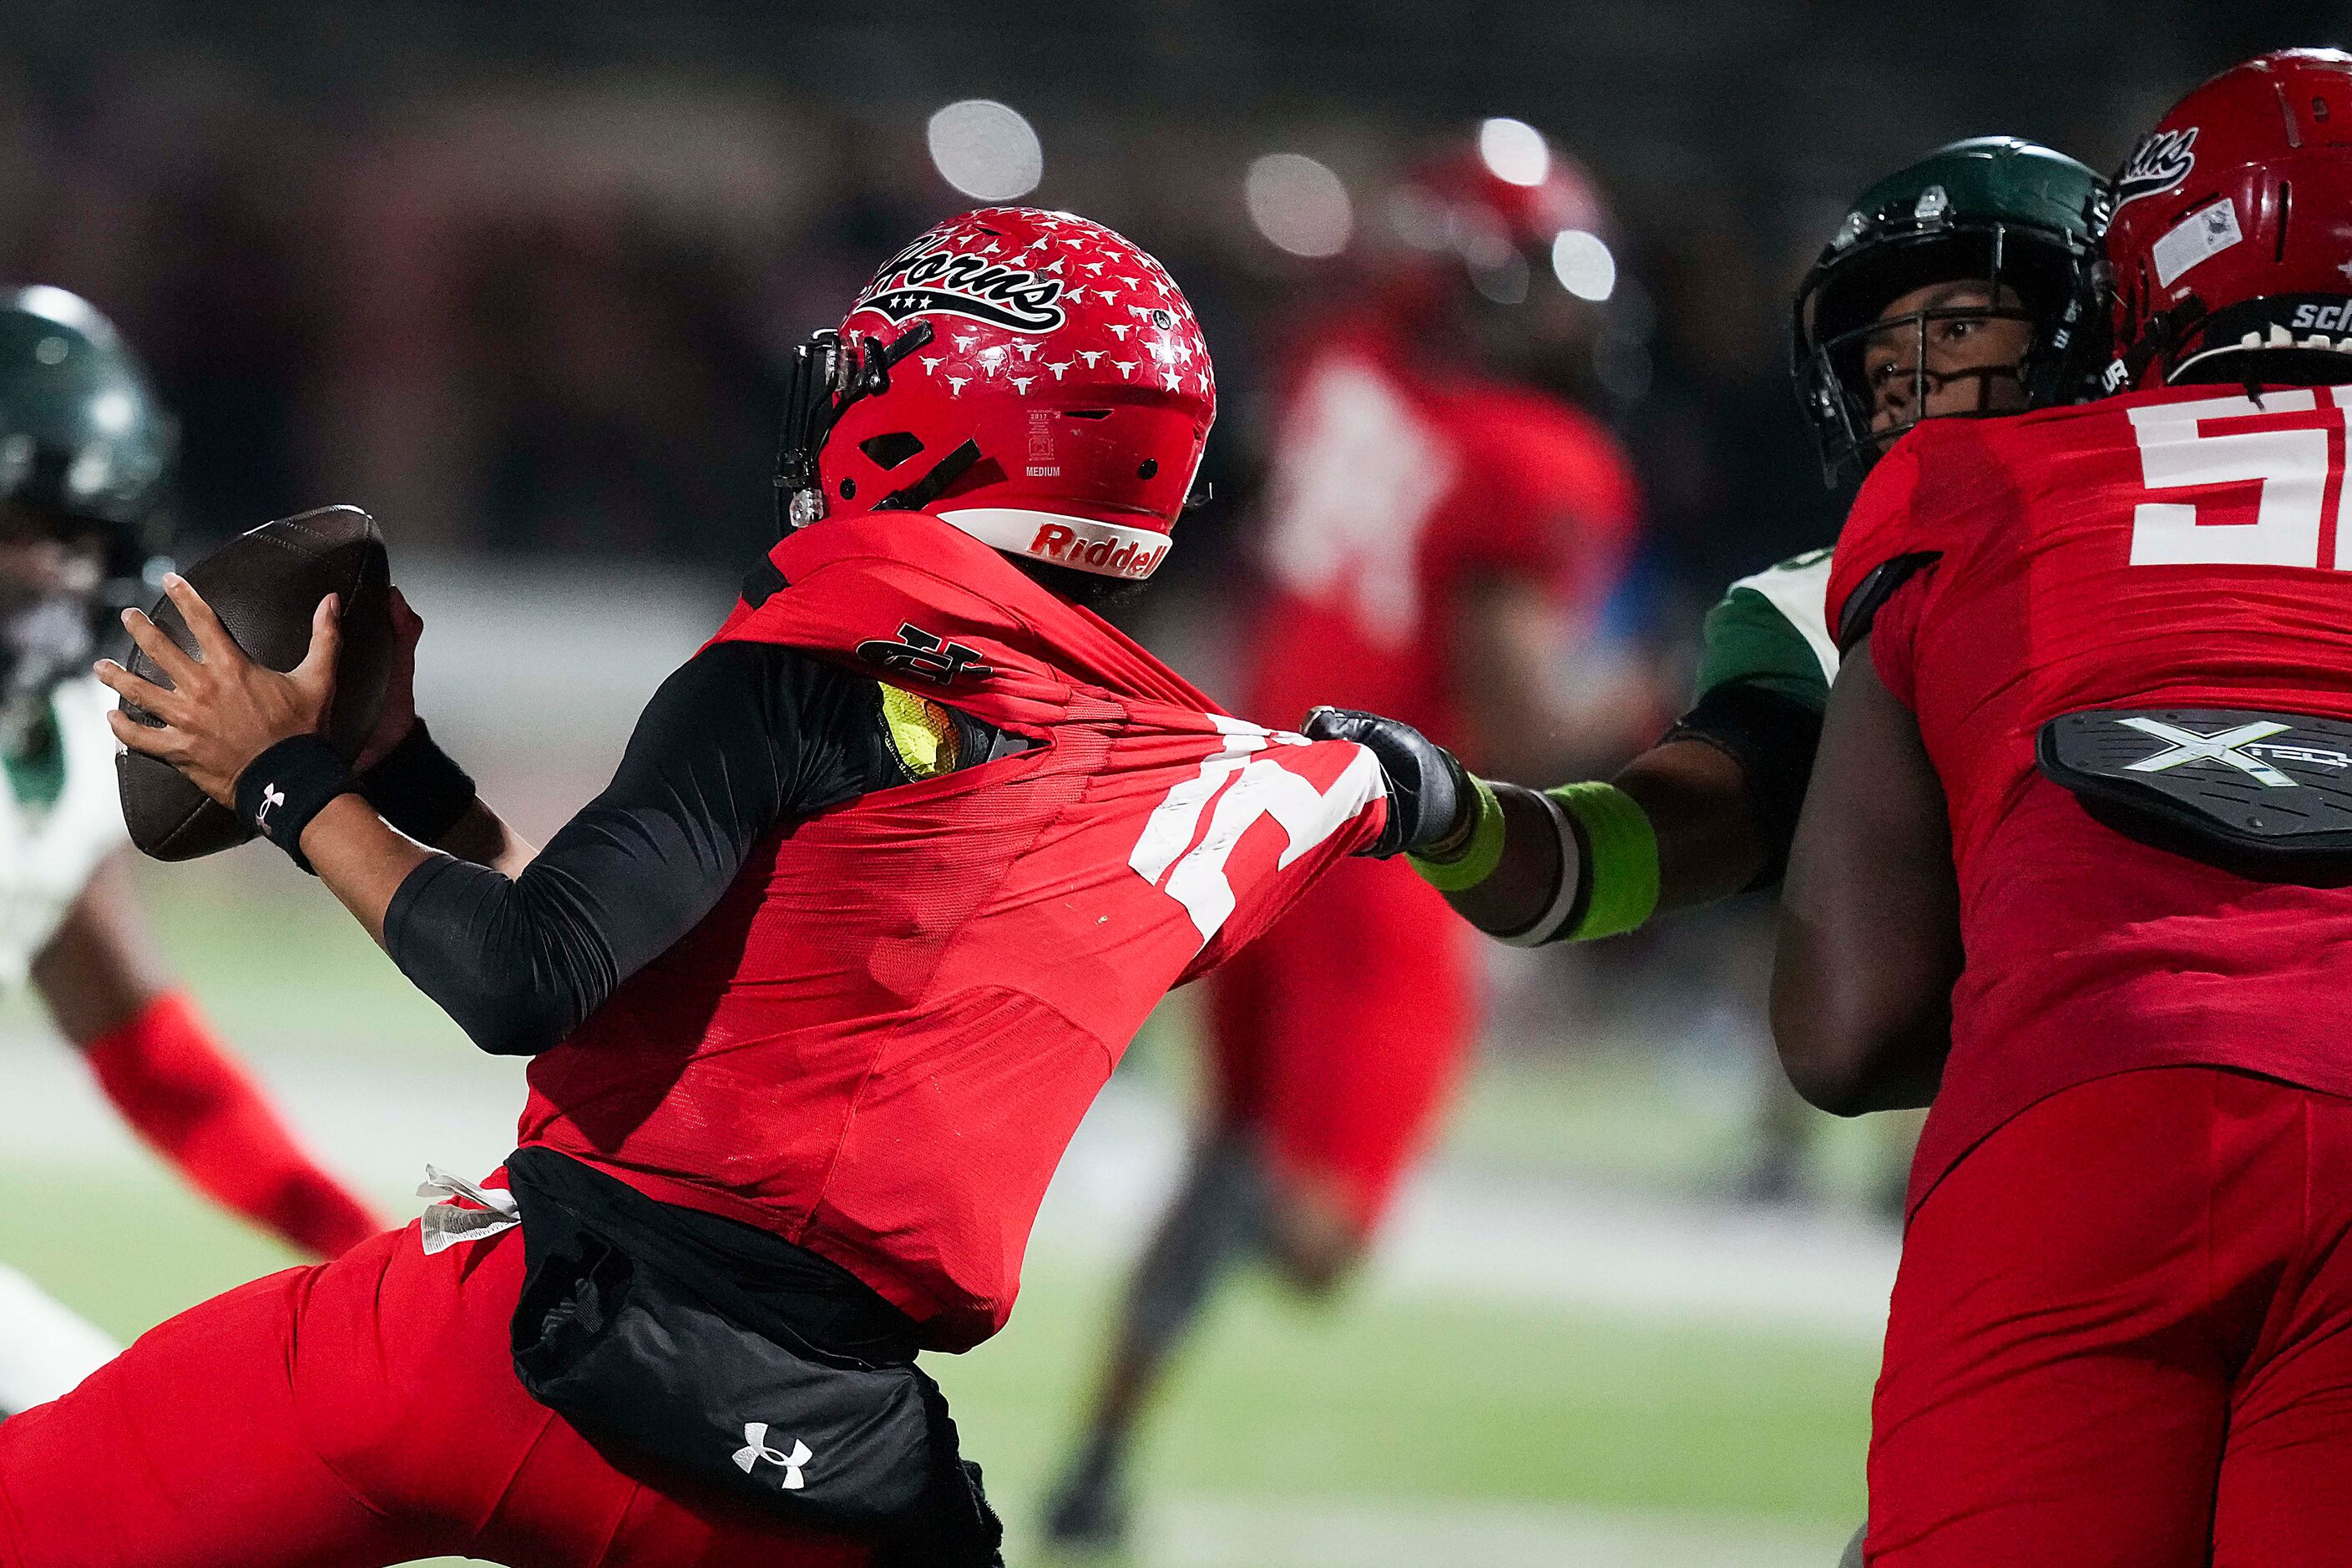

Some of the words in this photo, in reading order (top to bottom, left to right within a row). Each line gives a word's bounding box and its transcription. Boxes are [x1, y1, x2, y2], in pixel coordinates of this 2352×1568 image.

[1026, 467, 1060, 477] MEDIUM
[2127, 383, 2352, 571] 5
[1026, 523, 1168, 578] Riddell
